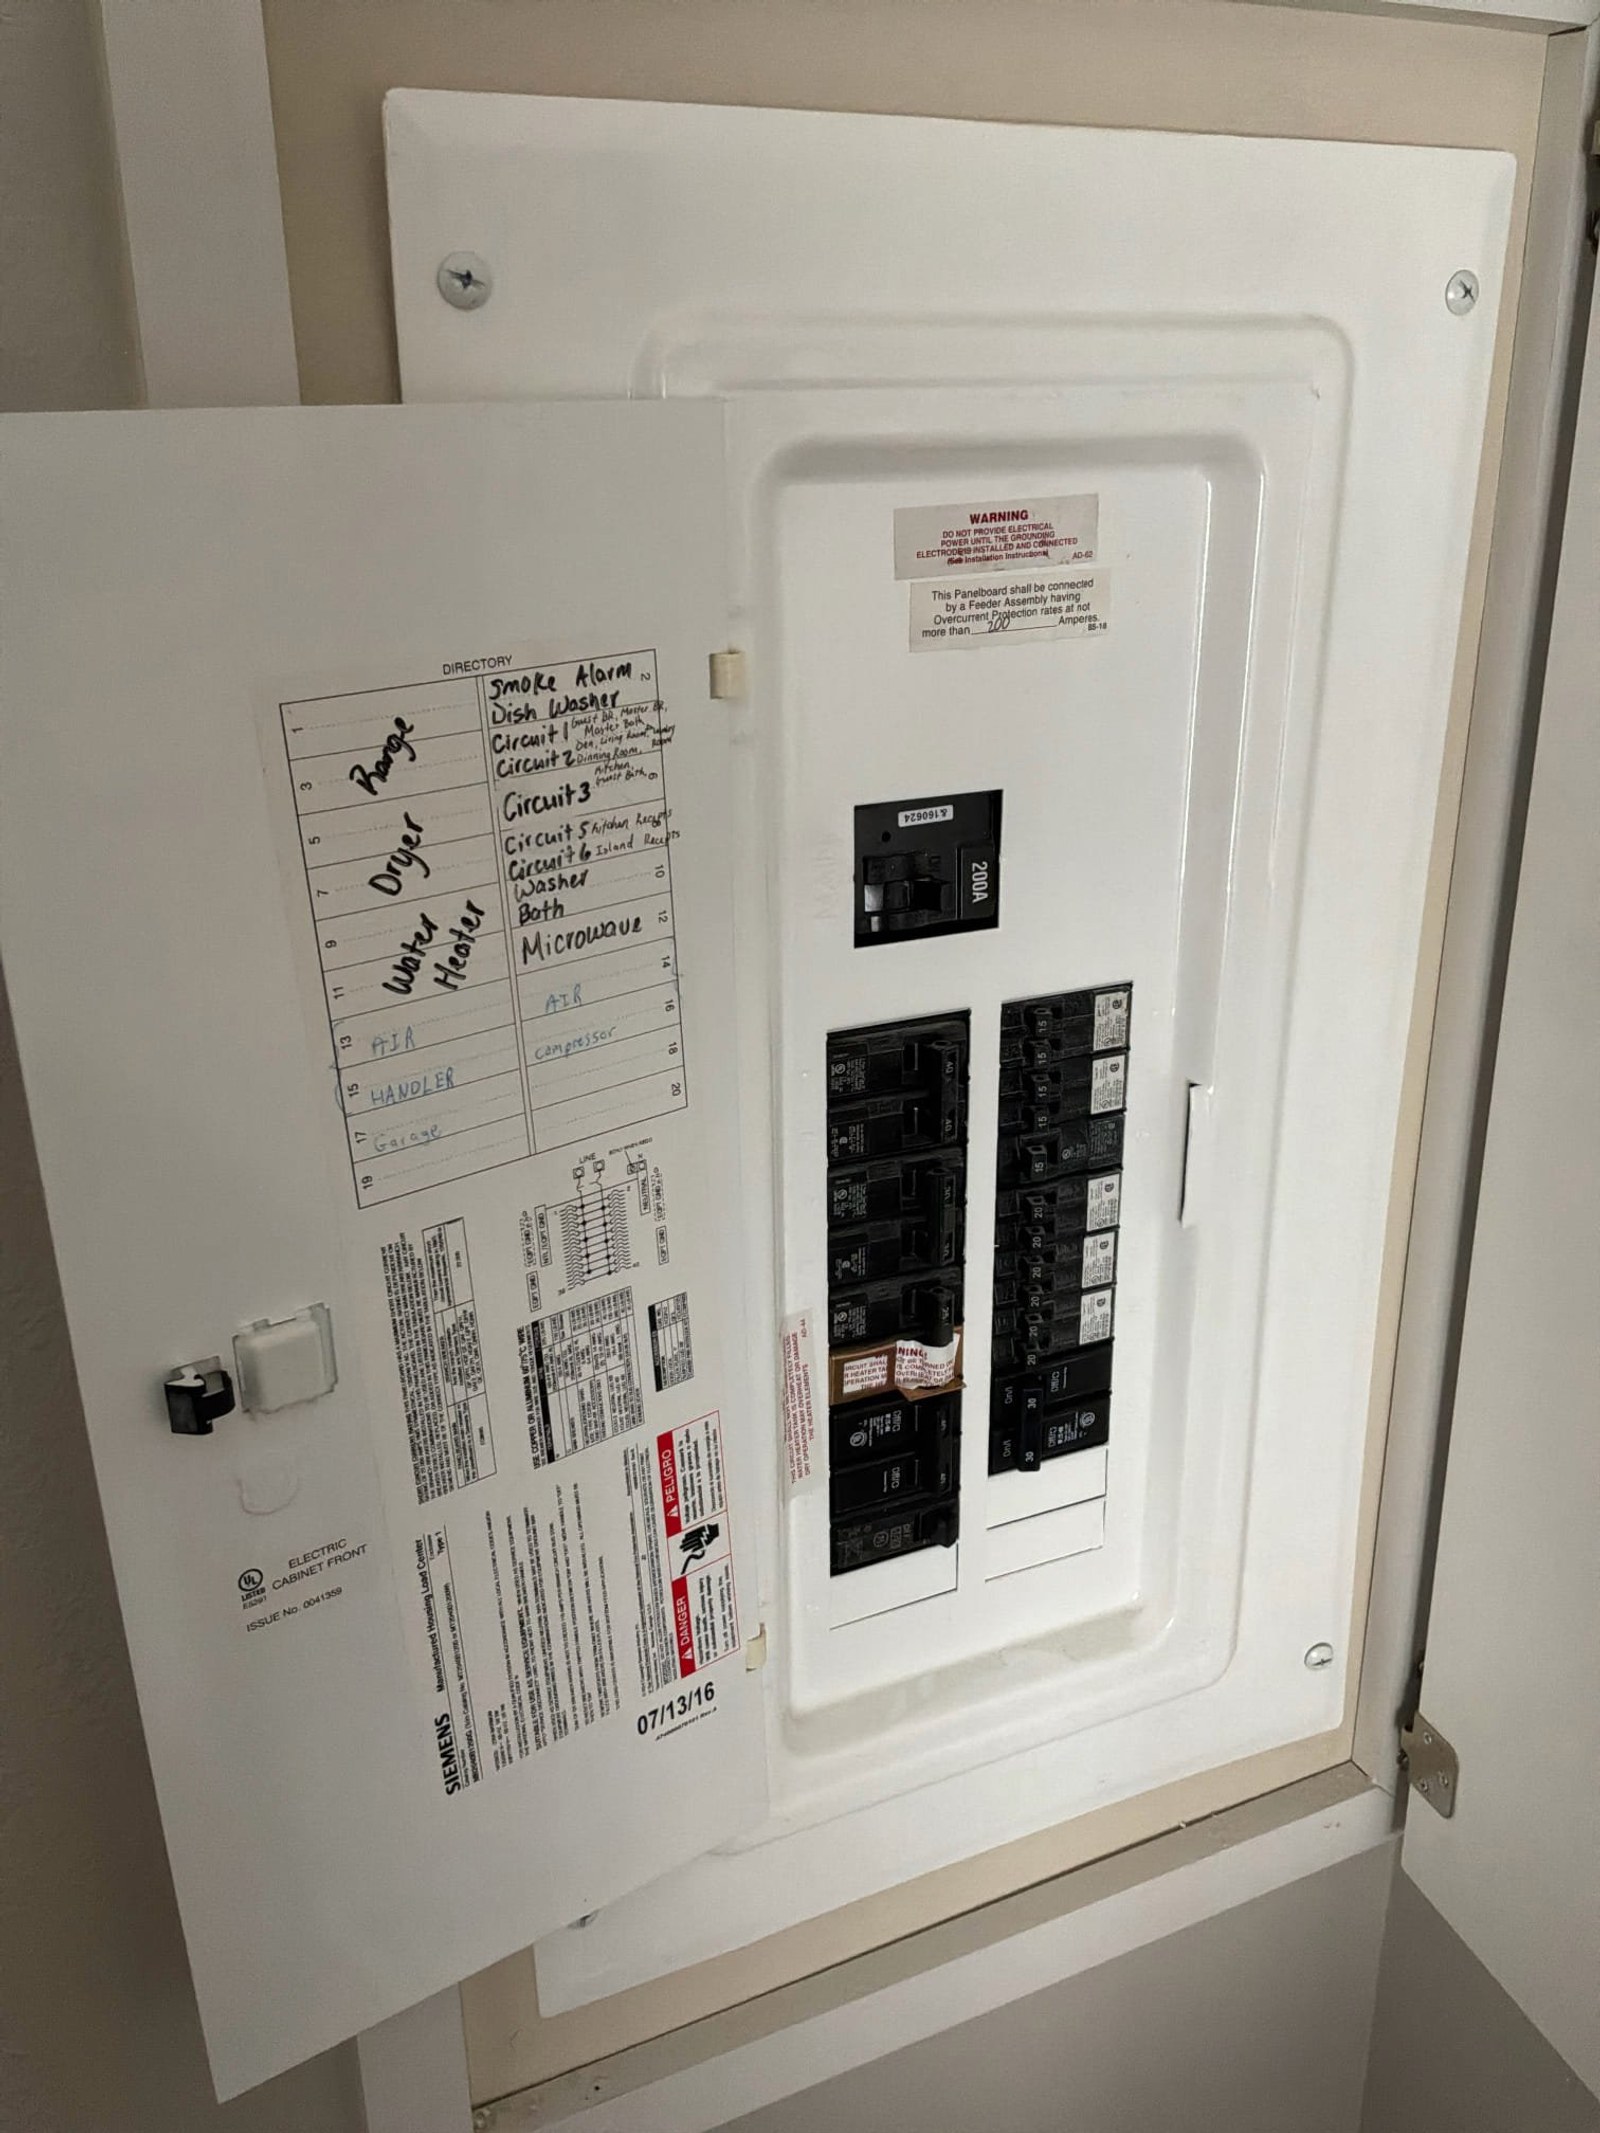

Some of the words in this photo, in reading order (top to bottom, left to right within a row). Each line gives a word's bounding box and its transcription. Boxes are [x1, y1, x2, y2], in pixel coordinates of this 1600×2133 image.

[970, 510, 1028, 524] WARNING
[943, 530, 954, 538] DO
[956, 529, 971, 537] NOT
[974, 526, 1006, 536] PROVIDE
[1008, 523, 1053, 533] ELECTRICAL
[941, 538, 968, 547] POWER
[971, 536, 992, 545] UNTIL
[1011, 531, 1055, 542] GROUNDING
[973, 543, 1014, 553] INSTALLED
[1033, 538, 1078, 548] CONNECTED
[965, 553, 1003, 563] Installation
[932, 590, 951, 601] This
[955, 586, 1008, 598] Panelboard
[1010, 583, 1032, 594] shall
[1034, 582, 1045, 593] be
[1048, 578, 1094, 592] connected
[945, 601, 957, 613] by
[959, 603, 966, 611] a
[969, 599, 1001, 610] Feeder
[1004, 594, 1048, 608] Assembly
[1051, 592, 1081, 604] having
[934, 613, 989, 626] Overcurrent
[992, 608, 1038, 620] Protection
[1040, 606, 1063, 616] rates
[1065, 605, 1074, 613] at
[1077, 602, 1090, 612] not
[1058, 615, 1100, 626] Amperes.
[986, 614, 1011, 634] 200
[922, 629, 946, 638] more
[949, 626, 971, 636] than
[442, 655, 513, 676] DIRECTORY
[489, 672, 557, 700] Smoke
[575, 662, 632, 688] Alarm
[640, 672, 650, 681] 2
[492, 702, 537, 725] Dish
[550, 690, 620, 719] Washer
[291, 726, 303, 734] 1
[492, 724, 558, 754] Circuit
[563, 722, 569, 741] 1
[350, 716, 416, 796] Range
[496, 749, 561, 778] Circuit
[562, 750, 576, 767] 2
[300, 782, 312, 791] 3
[504, 784, 576, 822] Circuit
[578, 781, 591, 803] 3
[308, 836, 320, 845] 5
[505, 823, 573, 855] Circuit
[578, 821, 590, 839] 5
[368, 812, 431, 896] Dryer
[508, 846, 575, 881] Circuit
[579, 842, 592, 862] 6
[654, 864, 665, 879] 10
[513, 868, 589, 902] Washer
[972, 861, 988, 903] 200A
[317, 890, 329, 898] 7
[518, 898, 565, 926] Bath
[658, 910, 668, 924] 12
[325, 940, 337, 949] 9
[433, 899, 486, 990] Heater
[521, 916, 642, 966] Microwave
[382, 912, 439, 995] Water
[660, 954, 672, 969] 14
[333, 985, 344, 1000] 11
[544, 983, 583, 1014] AIR
[665, 999, 676, 1013] 16
[1038, 1020, 1047, 1033] 15
[340, 1035, 351, 1049] 13
[372, 1024, 415, 1057] AIR
[668, 1041, 678, 1055] 18
[1038, 1052, 1047, 1065] 15
[347, 1083, 359, 1097] 15
[371, 1067, 455, 1106] HANDLER
[671, 1082, 682, 1097] 20
[1038, 1086, 1047, 1098] 15
[1038, 1116, 1047, 1128] 15
[355, 1131, 367, 1144] 17
[374, 1124, 443, 1152] Garage
[579, 1152, 596, 1164] LINE
[1035, 1162, 1044, 1173] 15
[362, 1175, 373, 1190] 19
[1034, 1207, 1043, 1218] 20
[1033, 1236, 1041, 1249] 20
[1033, 1266, 1041, 1279] 20
[1031, 1296, 1040, 1308] 20
[1029, 1326, 1037, 1338] 20
[1028, 1354, 1036, 1366] 20
[1027, 1397, 1036, 1409] 30
[1025, 1451, 1034, 1463] 30
[661, 1447, 676, 1503] PELIGRO
[288, 1538, 347, 1569] ELECTRIC
[412, 1537, 425, 1571] Center
[272, 1561, 324, 1590] CABINET
[327, 1543, 367, 1568] FRONT
[417, 1569, 429, 1594] Load
[421, 1592, 437, 1633] Housing
[247, 1612, 280, 1632] ISSUE
[676, 1594, 689, 1647] DANGER
[427, 1632, 444, 1693] Manufactured
[638, 1681, 714, 1735] 07/13/16
[434, 1710, 461, 1797] SIEMENS
